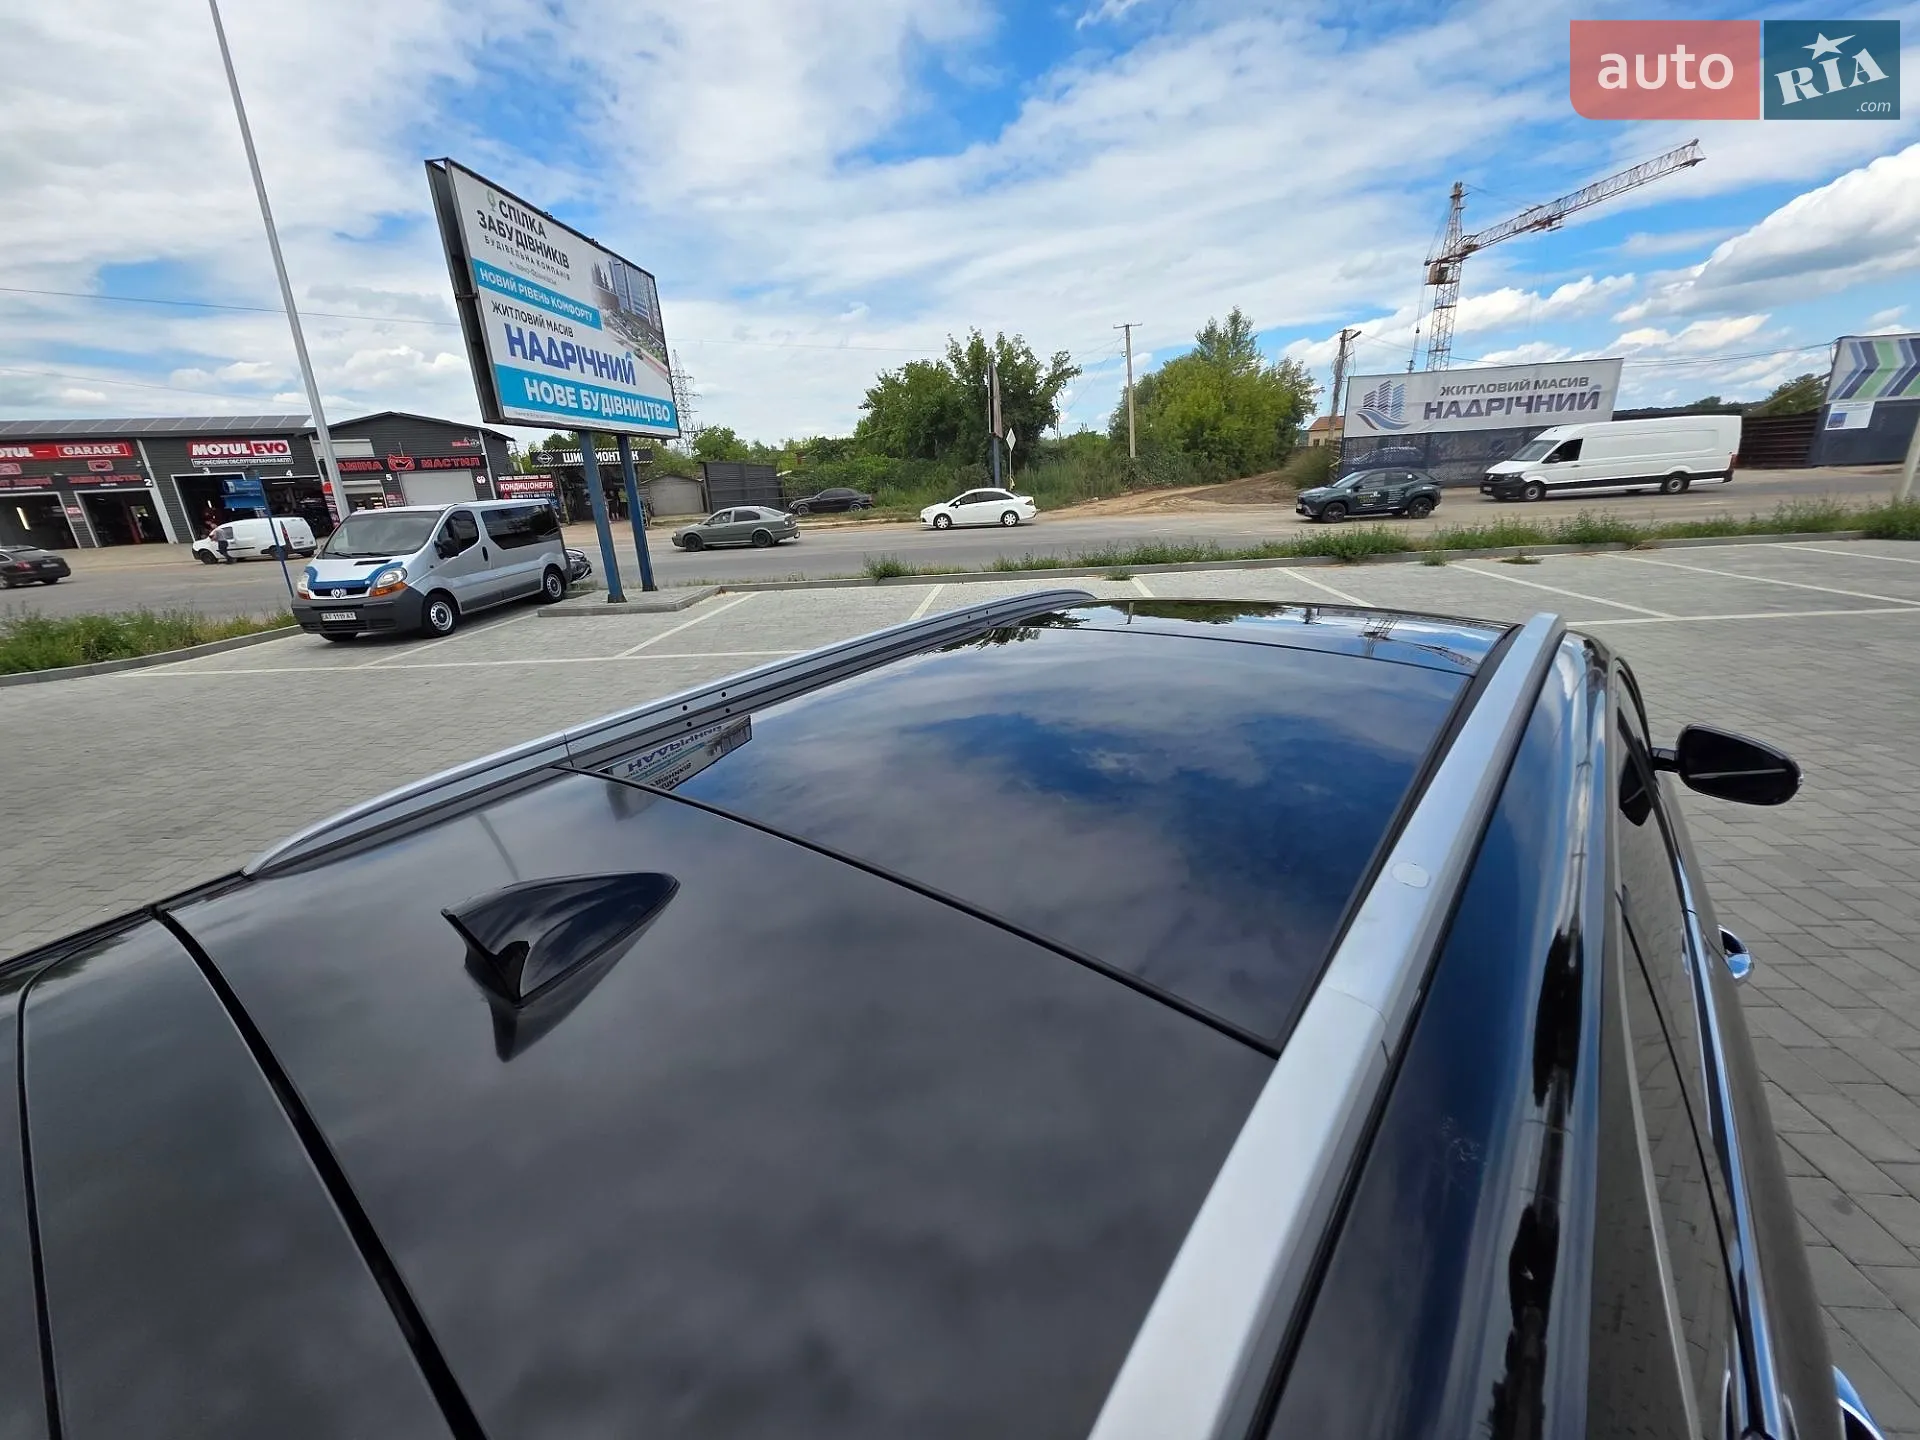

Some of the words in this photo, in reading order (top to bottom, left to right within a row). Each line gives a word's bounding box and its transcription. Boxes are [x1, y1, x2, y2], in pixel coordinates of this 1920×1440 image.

[498, 200, 547, 240] СПІЛКА
[476, 209, 570, 270] ЗАБУДІВНИКІВ
[479, 267, 516, 294] НОВИЙ
[518, 283, 550, 305] РІВЕНЬ
[550, 294, 594, 323] КОМФОРТУ
[492, 300, 546, 330] ЖИТЛОВИЙ
[547, 320, 574, 338] МАСИВ
[503, 322, 637, 386] НАДРІЧНИЙ
[523, 377, 579, 409] НОВЕ
[581, 388, 671, 423] БУДІВНИЦТВО
[1423, 385, 1604, 421] НАДРІЧНИЙ
[1440, 378, 1531, 397] ЖИТЛОВИЙ
[1533, 376, 1590, 391] МАСИВ
[0, 447, 34, 458] OTUL
[62, 445, 121, 456] GARAGE
[192, 443, 250, 456] MOTUL
[252, 442, 289, 455] EVO
[144, 478, 153, 486] 2
[386, 473, 393, 481] 5
[500, 481, 554, 493] КОНДИЦІОНЕРІВ
